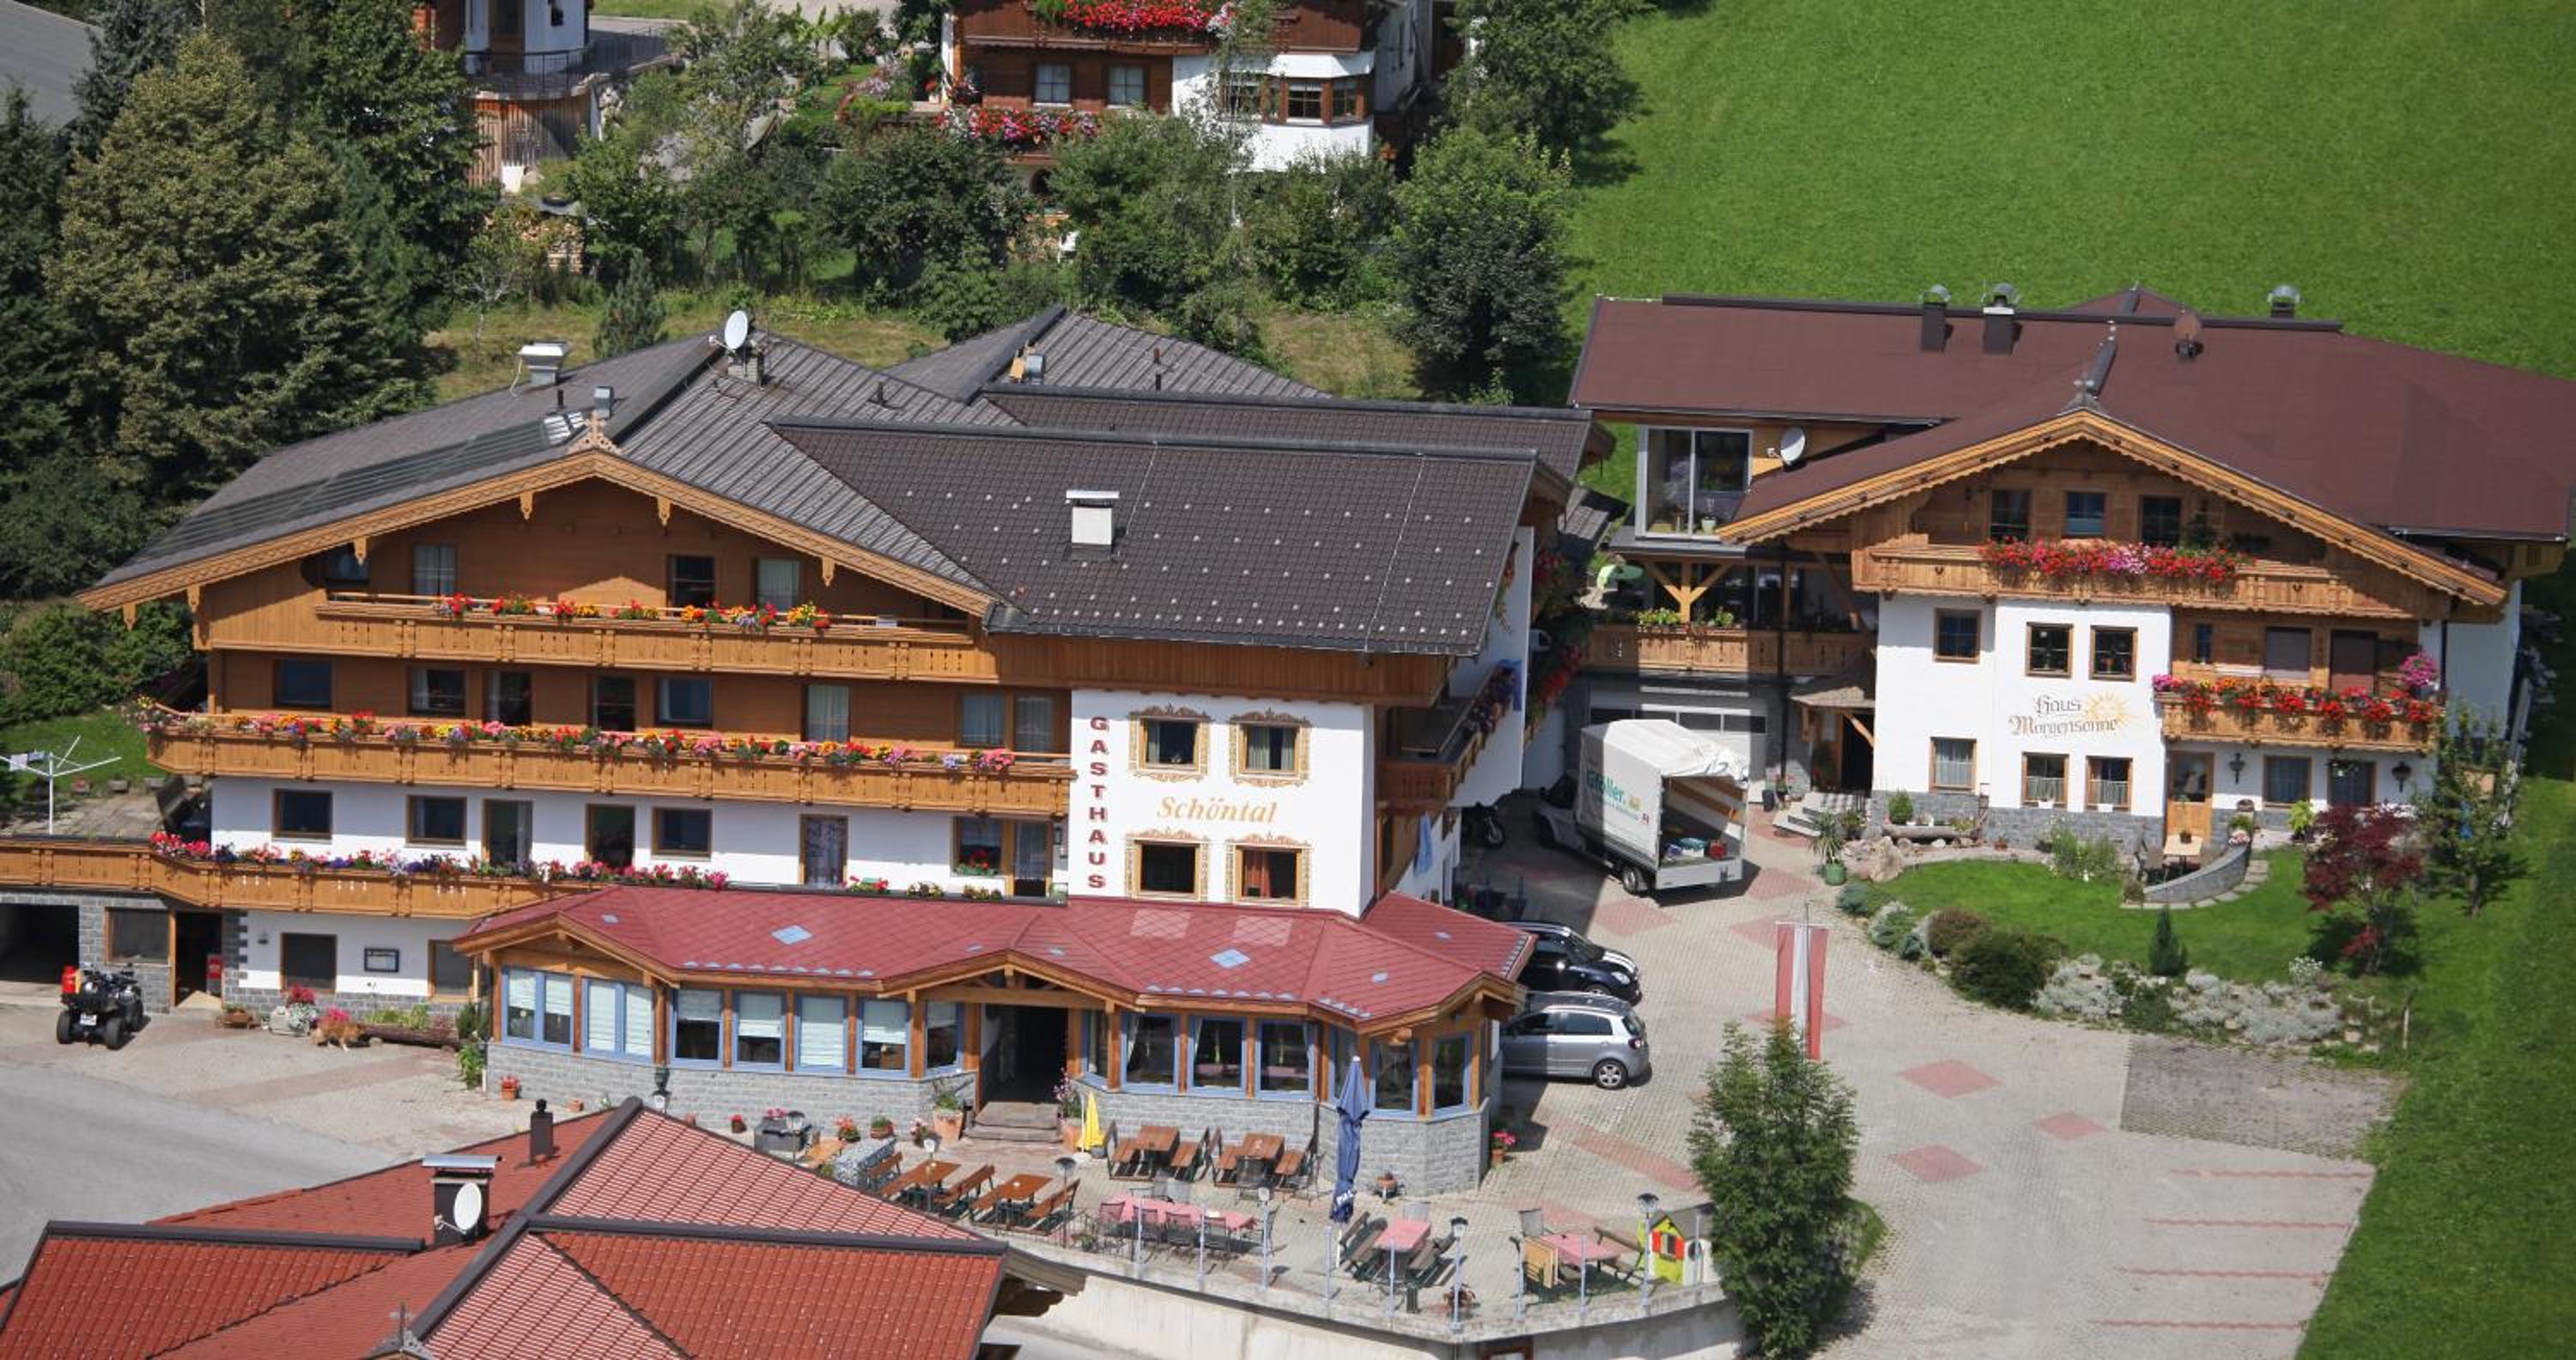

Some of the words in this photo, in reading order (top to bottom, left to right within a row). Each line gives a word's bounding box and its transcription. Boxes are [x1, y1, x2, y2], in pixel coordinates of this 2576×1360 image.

[2034, 695, 2081, 717] Haus
[2008, 714, 2118, 738] Morgensonne
[1088, 716, 1109, 889] GASTHAUS
[1157, 795, 1278, 824] Schöntal
